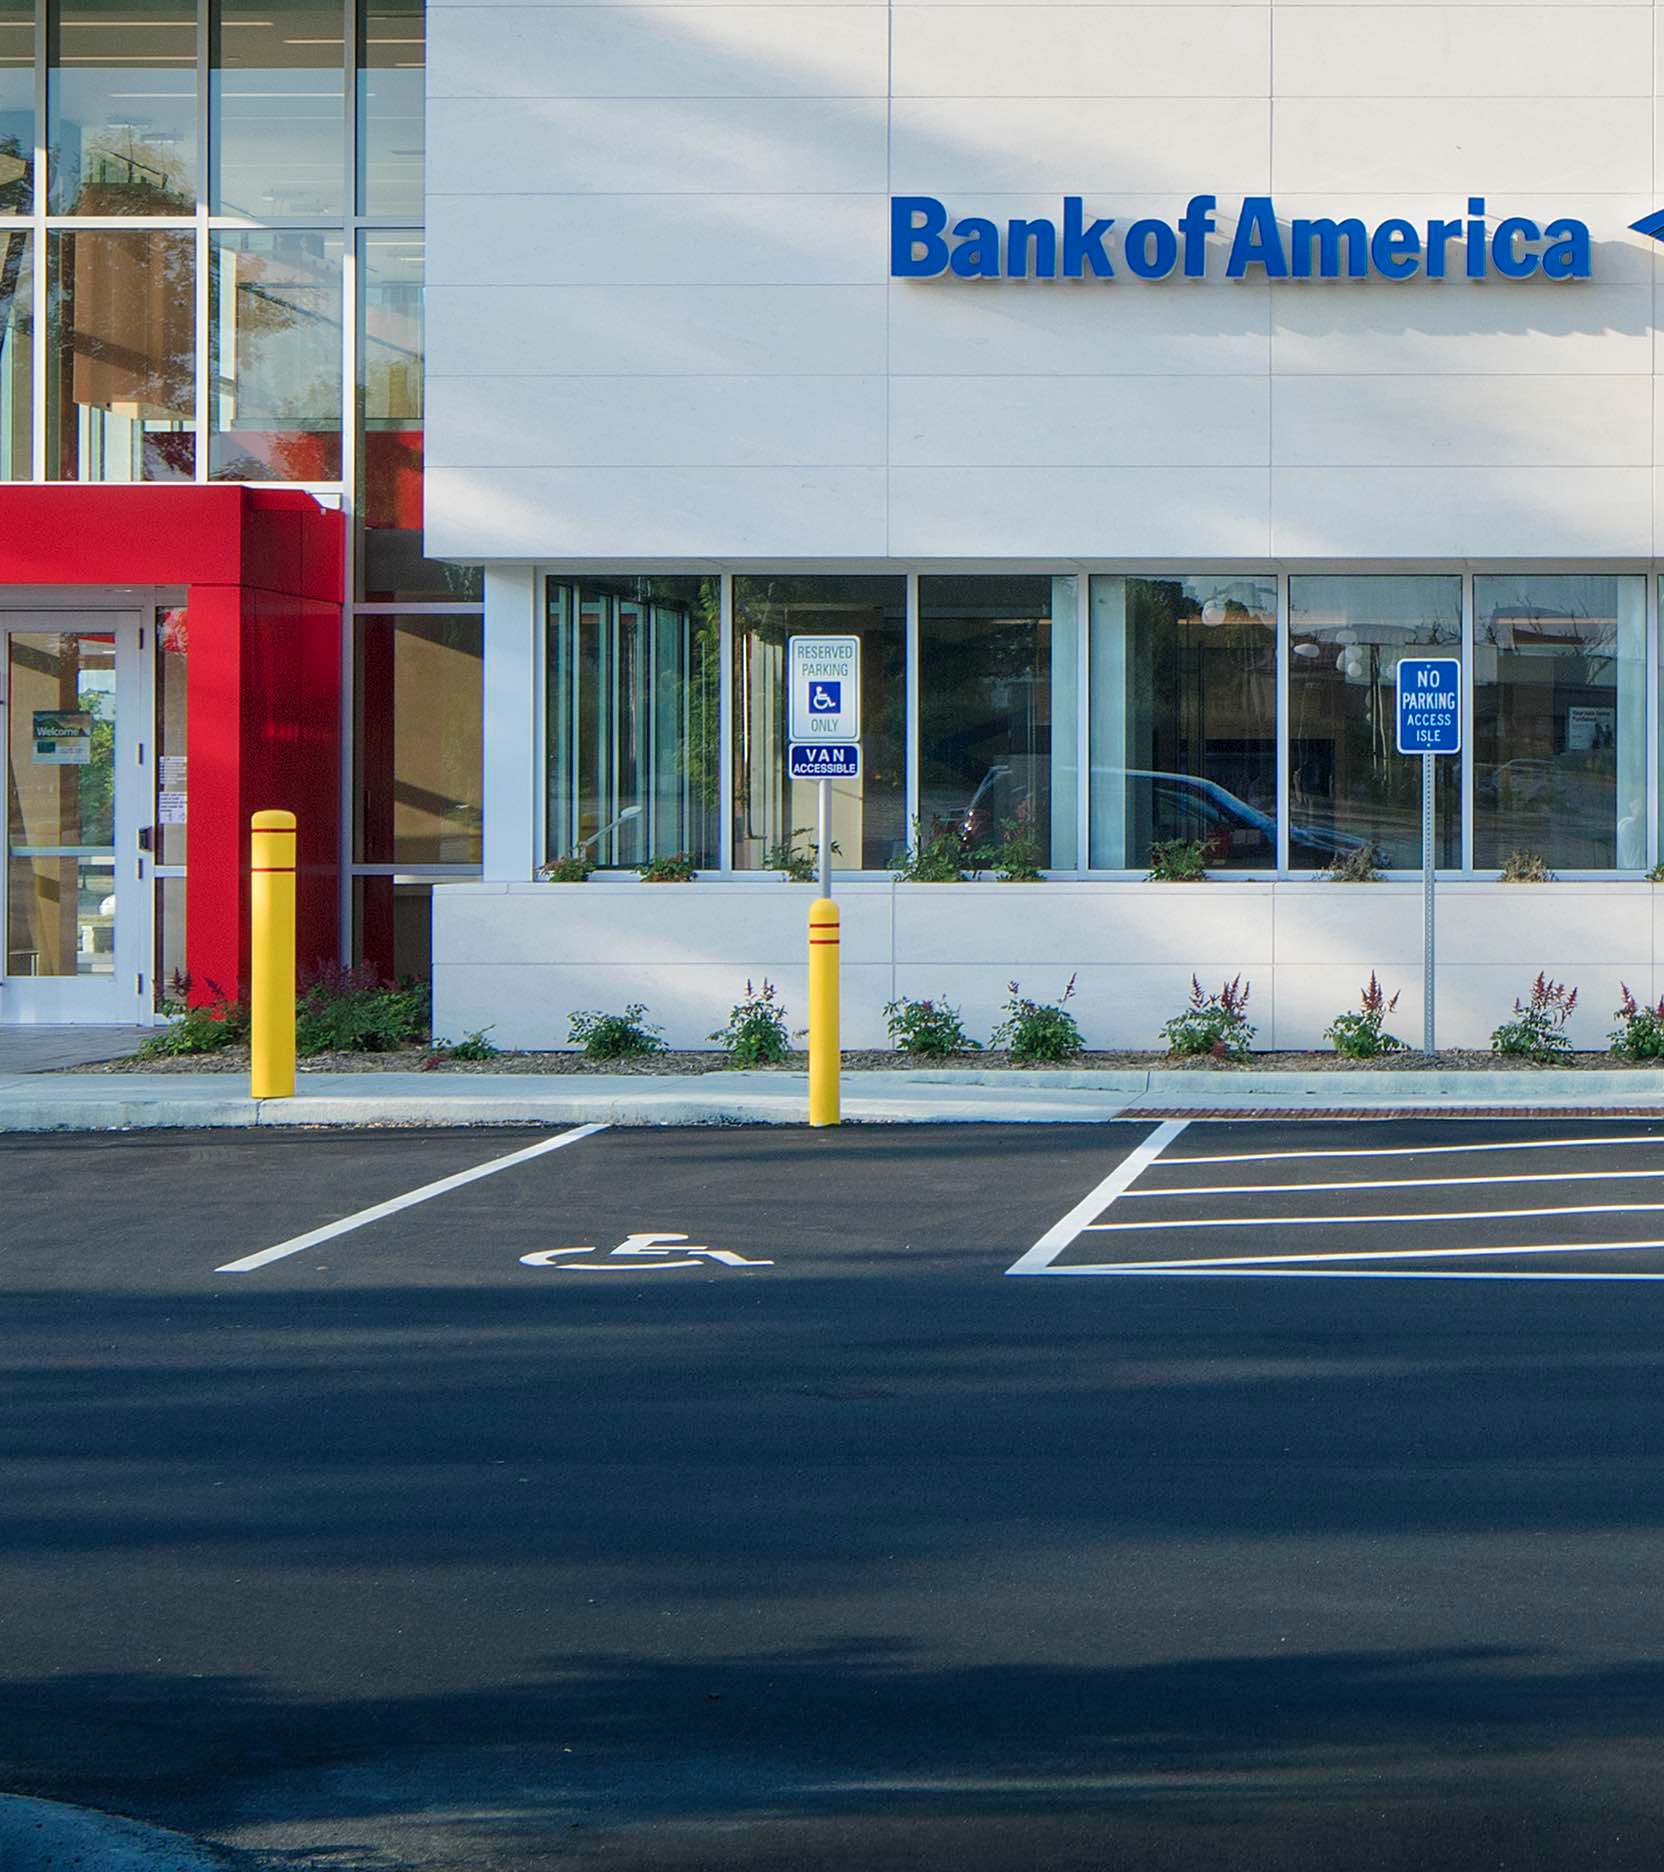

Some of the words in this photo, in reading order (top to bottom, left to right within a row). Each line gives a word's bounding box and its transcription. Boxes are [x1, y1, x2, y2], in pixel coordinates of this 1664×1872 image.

[890, 195, 1115, 280] Bank
[1124, 194, 1217, 280] of
[1225, 195, 1593, 281] America
[797, 646, 853, 659] RESERVED
[802, 663, 848, 676] PARKING
[1417, 670, 1440, 688] NO
[1402, 692, 1456, 710] PARKING
[811, 720, 839, 732] ONLY
[1407, 713, 1452, 726] ACCESS
[36, 727, 79, 737] Welcome
[1416, 729, 1441, 742] ISLE
[806, 748, 845, 762] VAN
[793, 763, 856, 774] ACCESSIBLE
